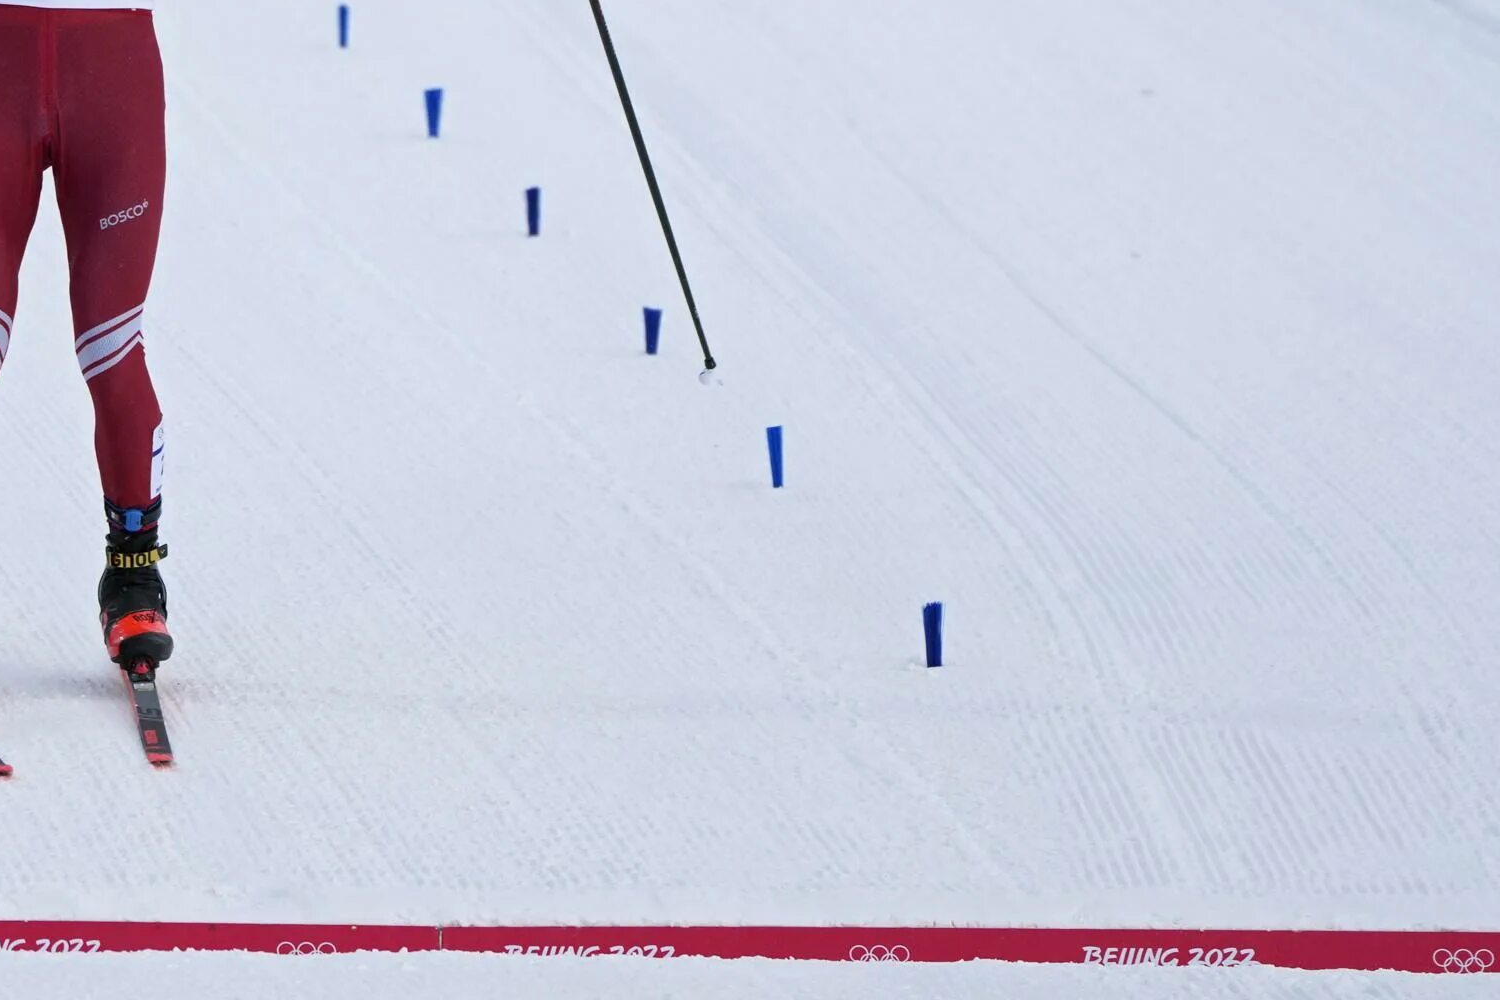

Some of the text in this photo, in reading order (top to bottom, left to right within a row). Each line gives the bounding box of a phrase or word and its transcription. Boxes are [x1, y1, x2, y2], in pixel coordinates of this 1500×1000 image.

[99, 204, 144, 230] BOSCO
[1082, 946, 1258, 967] BEIJING 2022
